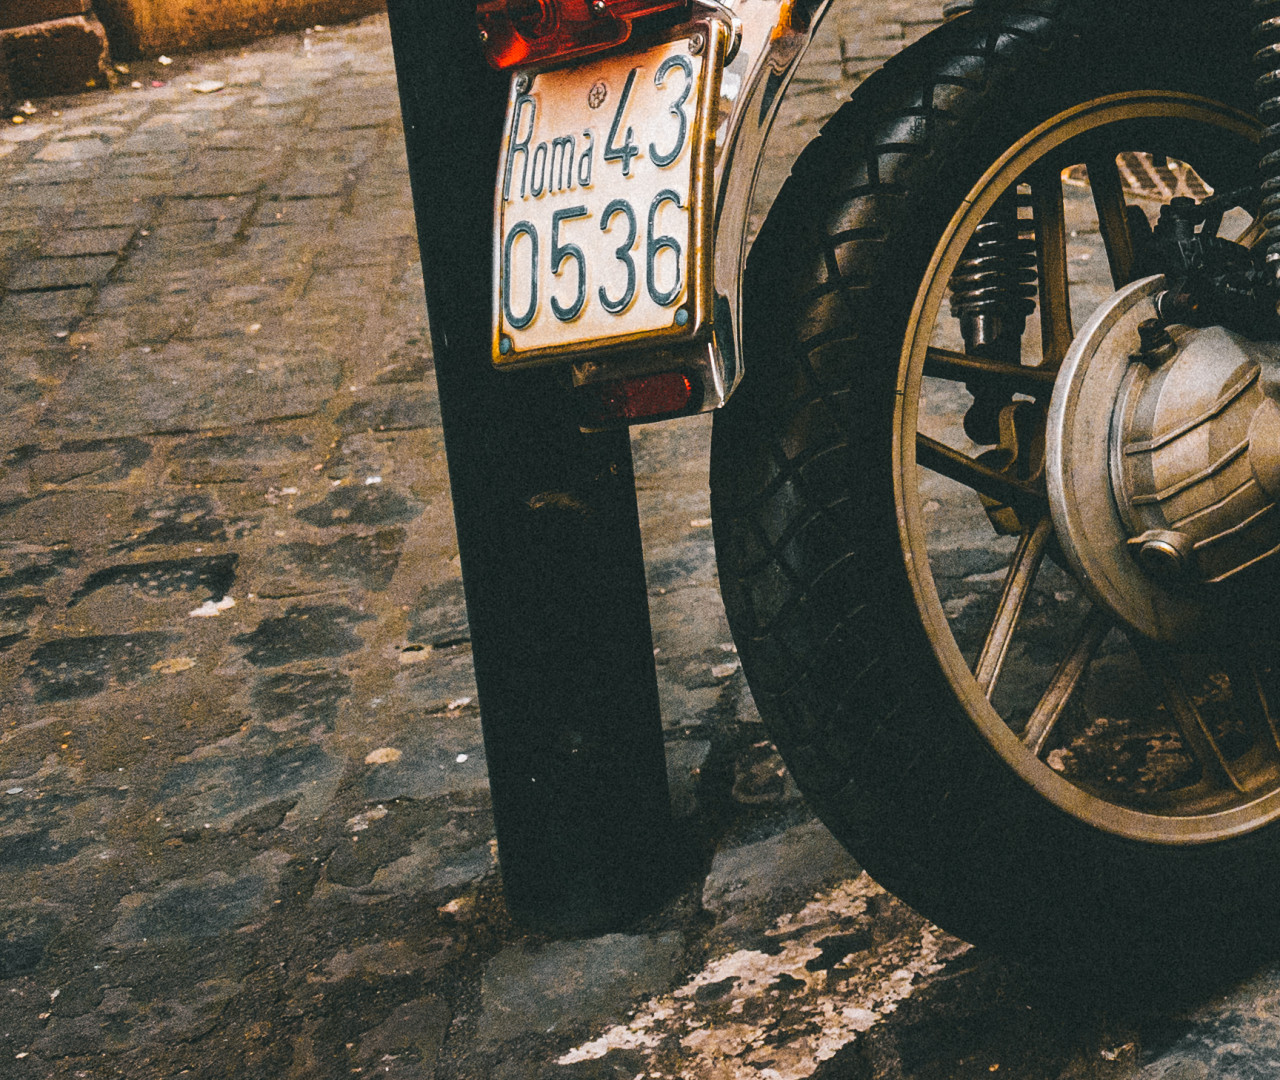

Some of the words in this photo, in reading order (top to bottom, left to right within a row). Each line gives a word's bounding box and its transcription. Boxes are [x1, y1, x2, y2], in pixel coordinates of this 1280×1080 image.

[503, 95, 592, 202] Roma
[604, 54, 693, 176] 43
[503, 189, 685, 329] 0536
